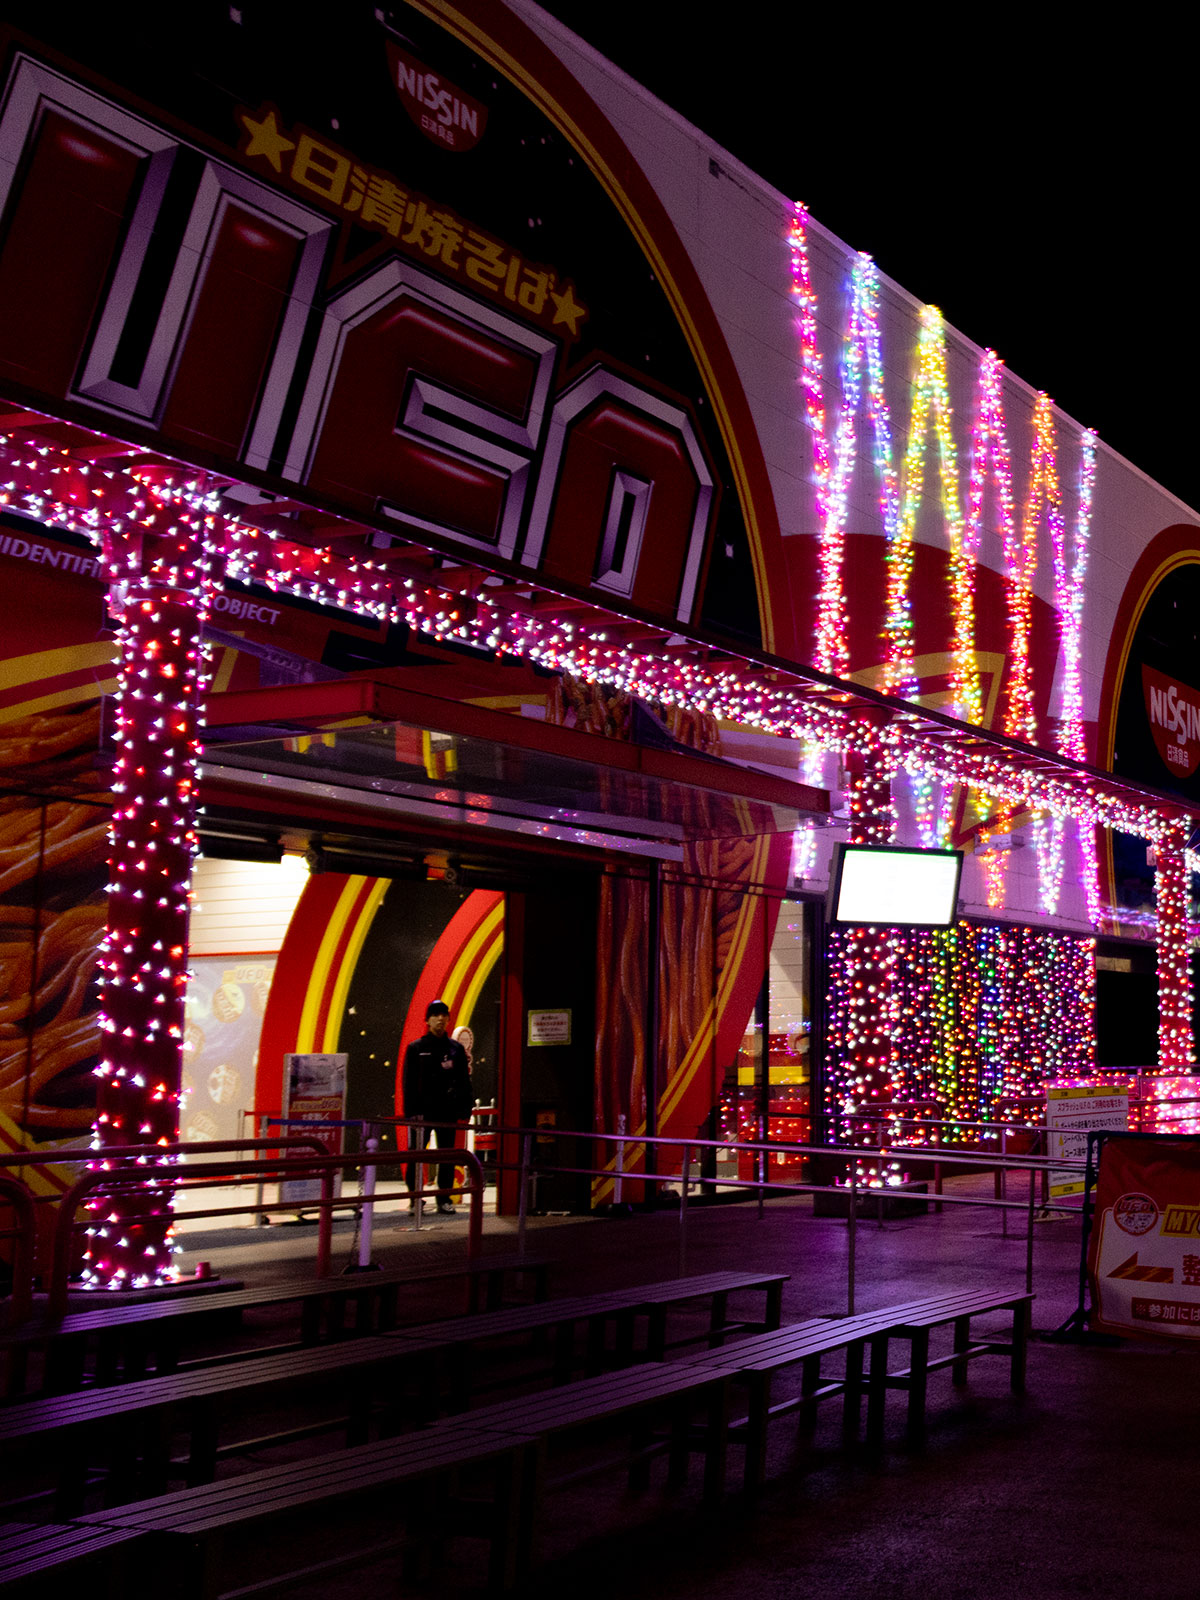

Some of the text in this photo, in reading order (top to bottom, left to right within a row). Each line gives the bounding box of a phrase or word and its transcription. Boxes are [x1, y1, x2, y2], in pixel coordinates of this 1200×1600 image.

[397, 61, 478, 138] NISSIN
[0, 533, 103, 579] IDENTIFI
[213, 594, 281, 625] OBJECT
[1167, 744, 1190, 768] 日清食品
[1164, 1211, 1199, 1234] MY
